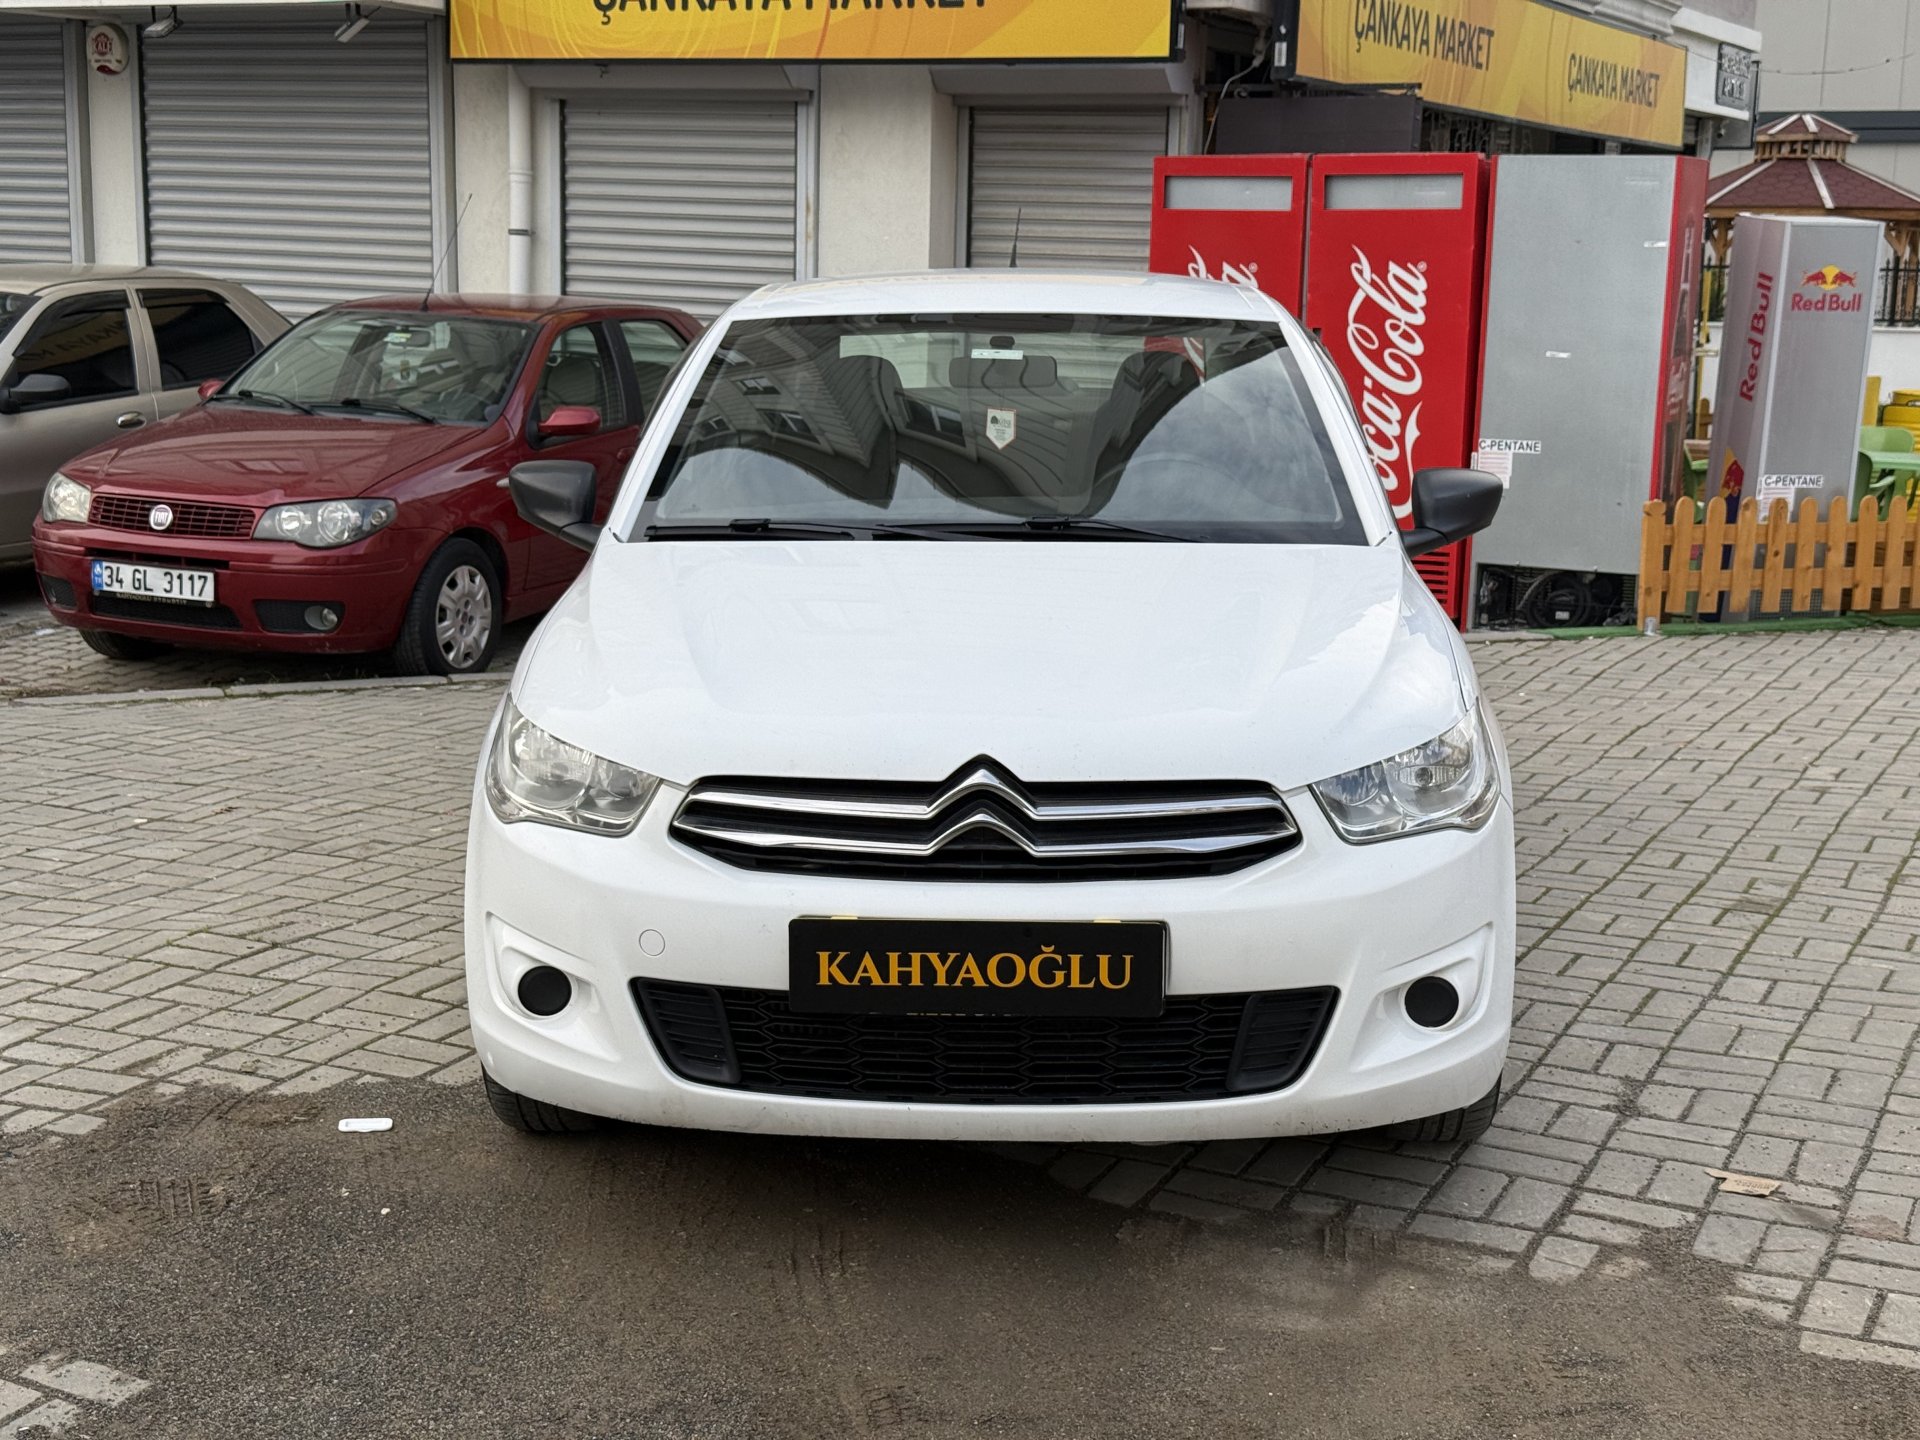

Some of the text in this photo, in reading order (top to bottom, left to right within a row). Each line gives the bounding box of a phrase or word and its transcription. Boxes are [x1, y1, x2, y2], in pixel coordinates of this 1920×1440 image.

[1355, 0, 1495, 71] ÇANKAYA MARKET
[1567, 53, 1660, 108] ÇANKAYA MARKET
[1791, 293, 1862, 312] Red Bull
[1739, 271, 1774, 402] Red Bull
[1347, 244, 1428, 518] oca-Cola
[1479, 440, 1541, 452] C-PENTANE
[1764, 475, 1823, 487] C-PENTANE
[154, 511, 169, 525] FIAT
[104, 566, 124, 589] 34
[132, 568, 154, 592] GL
[163, 571, 208, 597] 3117
[816, 944, 1134, 989] KAHYAOĞLU
